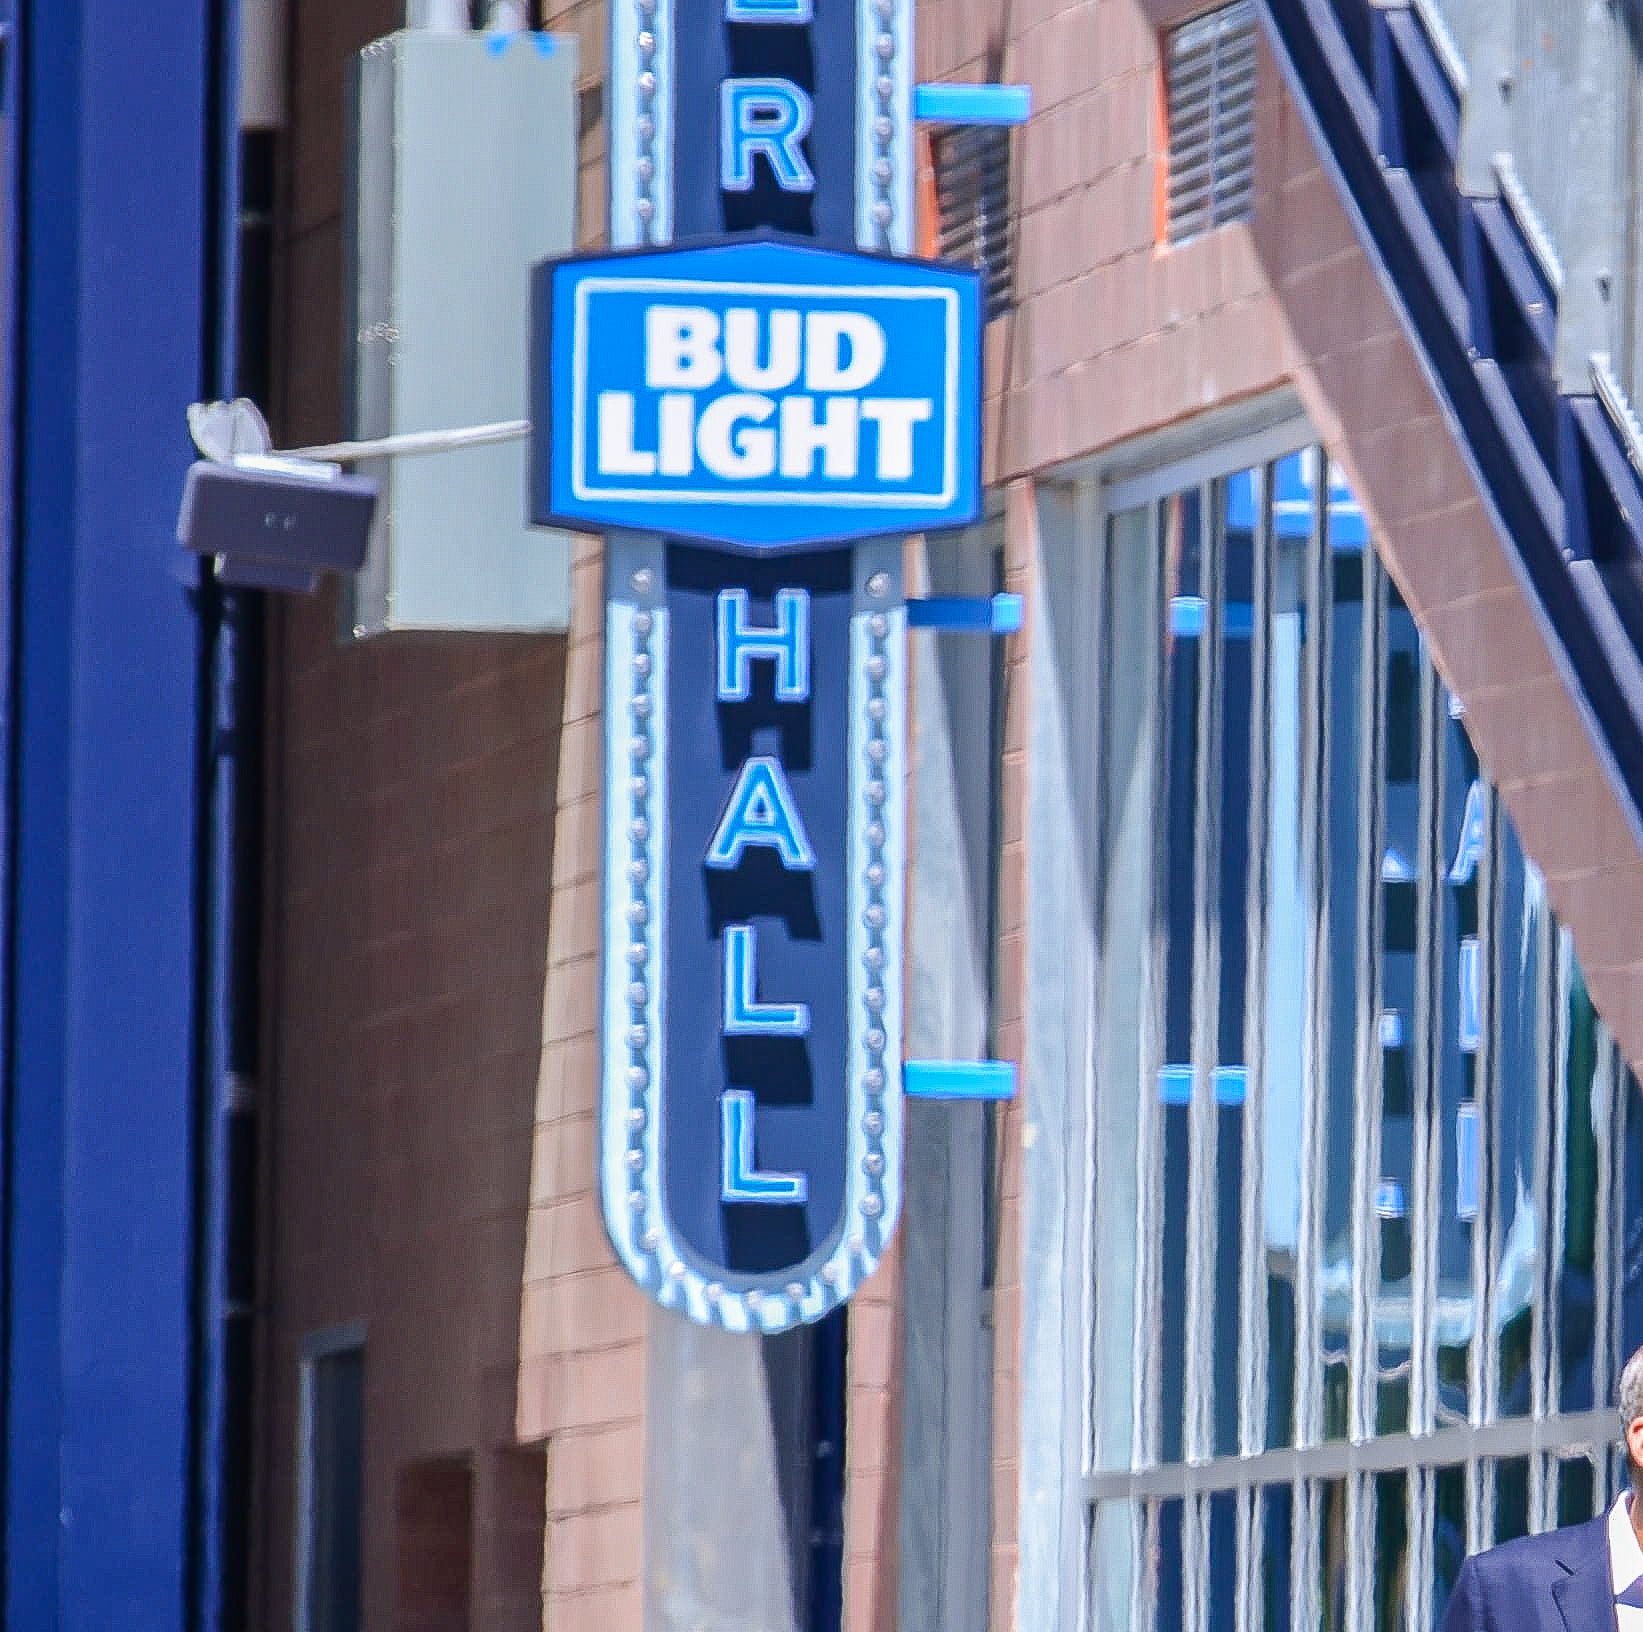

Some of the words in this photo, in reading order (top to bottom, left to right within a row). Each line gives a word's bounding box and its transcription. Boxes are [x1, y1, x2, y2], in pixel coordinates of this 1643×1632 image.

[720, 0, 816, 191] R
[645, 305, 886, 392] BUD
[597, 392, 932, 480] LIGHT
[706, 588, 817, 1202] HALL
